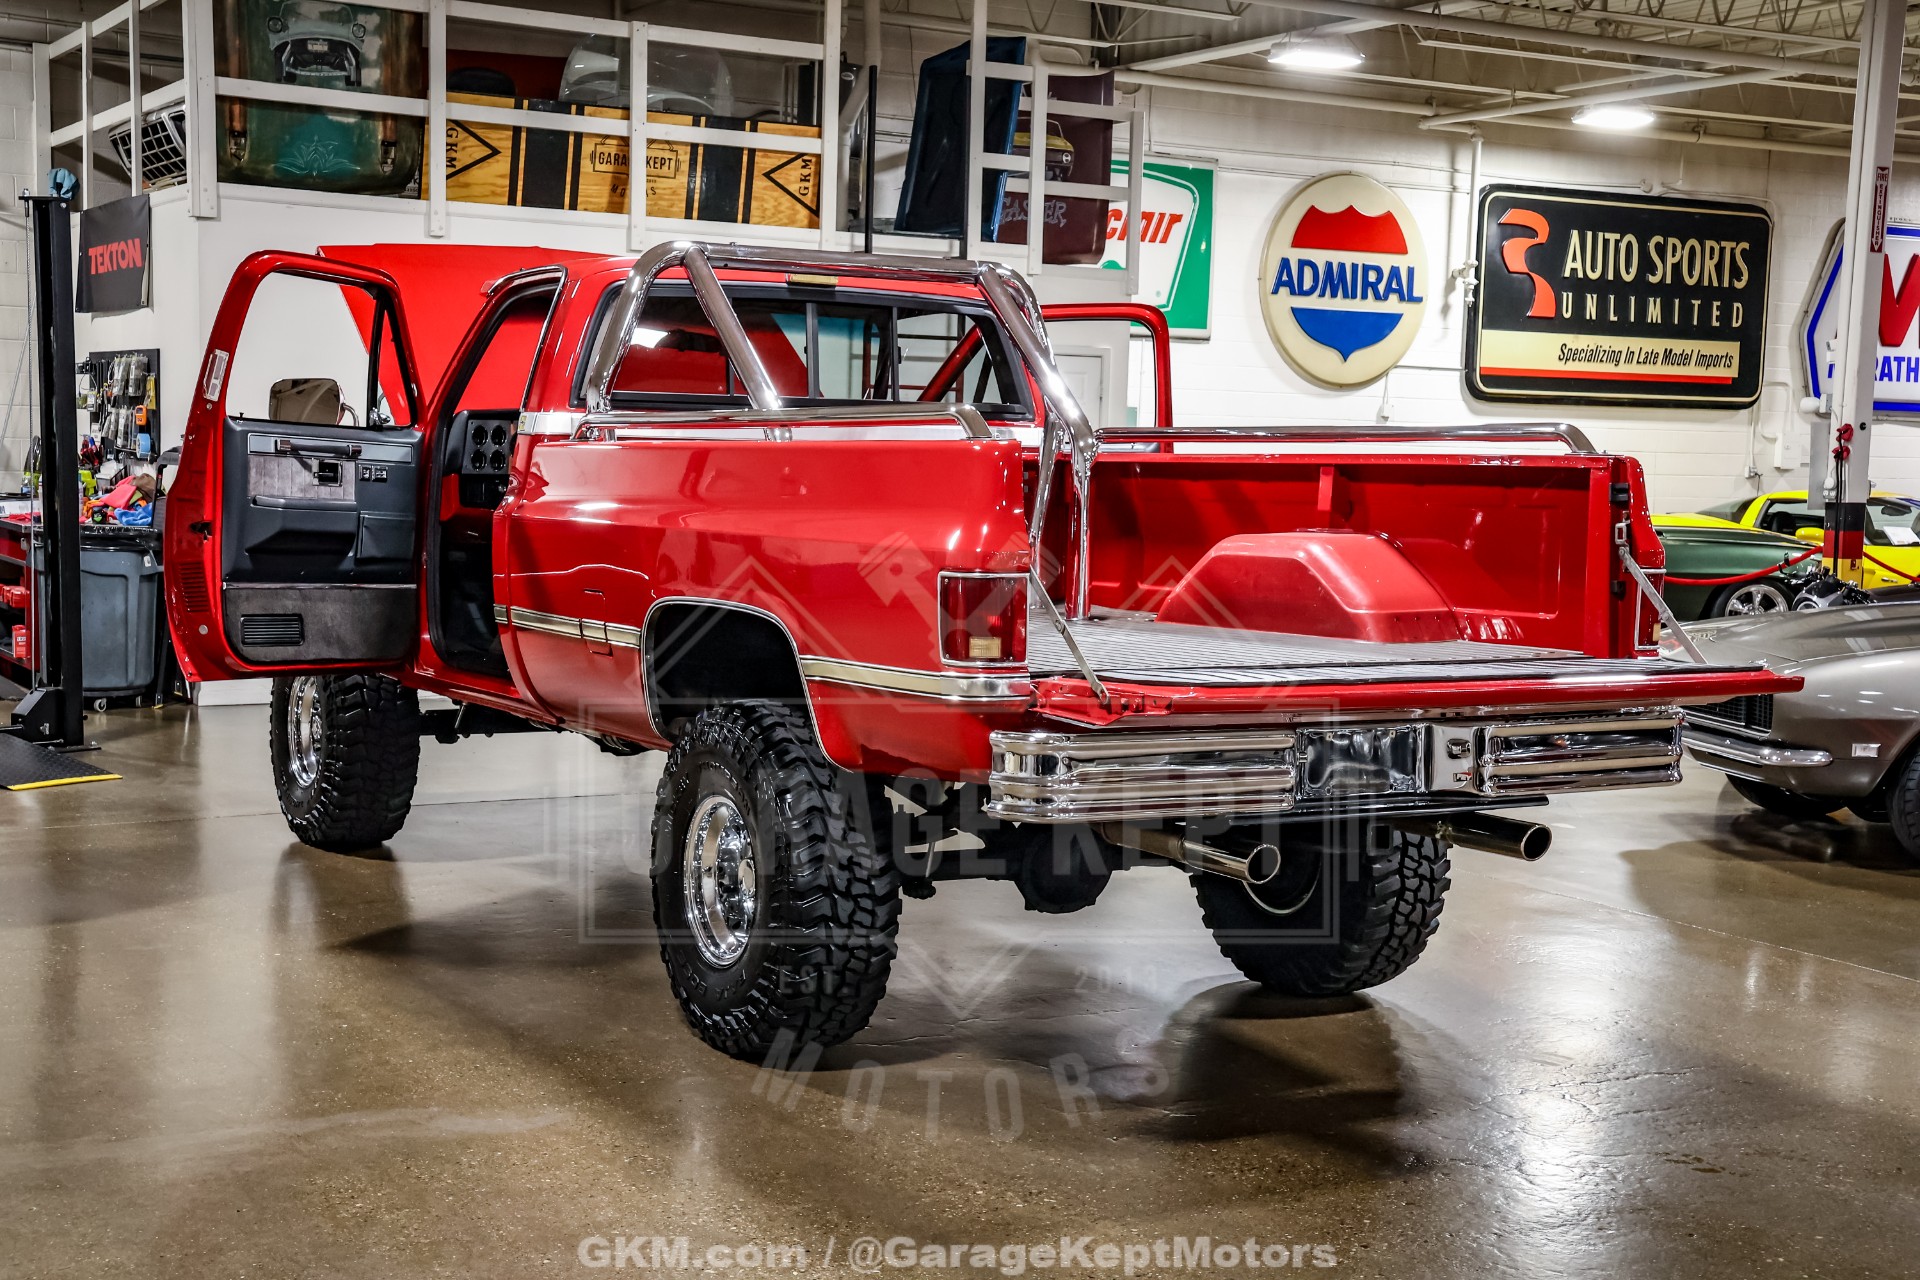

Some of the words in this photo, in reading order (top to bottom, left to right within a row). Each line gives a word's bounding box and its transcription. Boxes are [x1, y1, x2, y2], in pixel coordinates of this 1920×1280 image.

[598, 151, 630, 167] GARA
[798, 158, 813, 196] GKM
[88, 238, 142, 275] TEKTON
[1562, 229, 1639, 283] AUTO
[1646, 235, 1750, 289] SPORTS
[1271, 257, 1424, 303] ADMIRAL
[1561, 291, 1744, 328] UNLIMITED
[1558, 343, 1621, 367] Specializing
[1624, 346, 1635, 364] In
[1636, 347, 1659, 365] Late
[1661, 348, 1693, 366] Model
[1695, 349, 1734, 370] Imports
